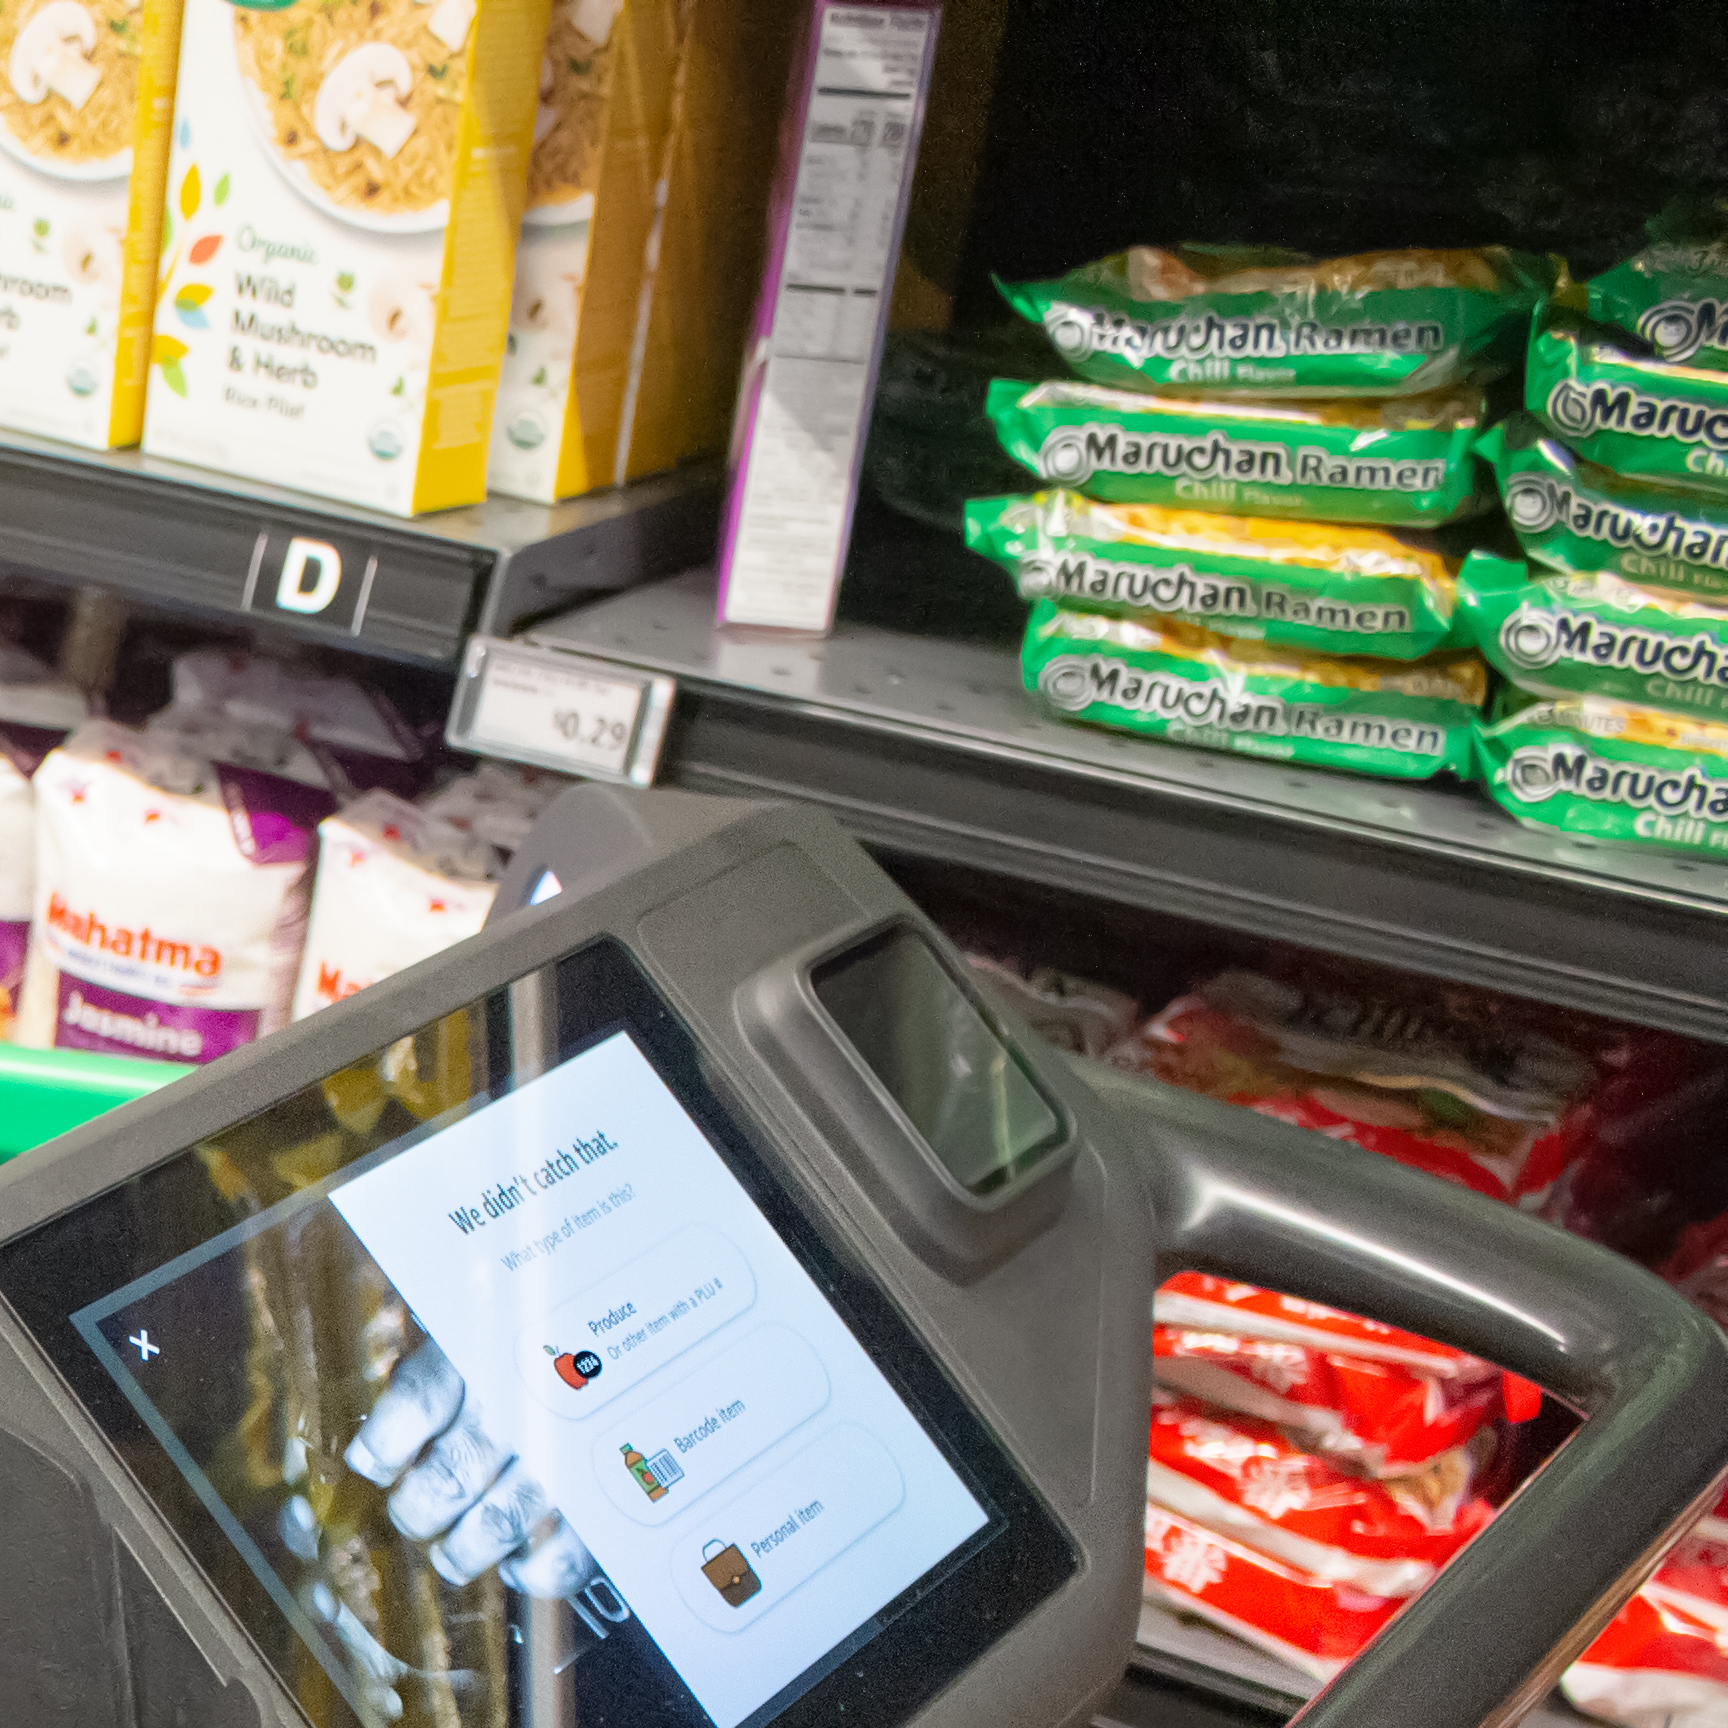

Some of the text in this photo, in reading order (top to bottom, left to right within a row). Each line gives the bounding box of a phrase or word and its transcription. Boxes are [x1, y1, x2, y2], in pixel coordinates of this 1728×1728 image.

[236, 224, 318, 265] Organic
[235, 270, 295, 308] Wild
[232, 309, 376, 364] Mushroom
[1091, 312, 1443, 358] Maruchan Ramen
[227, 345, 318, 389] & Herb
[1085, 430, 1282, 478] Maruchan
[276, 536, 341, 614] D
[1055, 558, 1247, 610] Maruchan
[1264, 591, 1407, 631] Ramen
[1089, 662, 1442, 755] Maruchan Ramen
[46, 891, 222, 977] Mahatma
[62, 990, 203, 1056] Jasmine
[448, 1128, 619, 1235] We didn't catch that.
[500, 1181, 636, 1272] What type of item is this?
[587, 1302, 637, 1337] Produce
[606, 1345, 623, 1360] Or
[622, 1328, 648, 1353] other
[644, 1313, 671, 1336] item
[667, 1299, 690, 1322] with
[693, 1281, 717, 1303] PLU
[673, 1399, 746, 1454] Barcode item
[749, 1499, 825, 1559] Personal item
